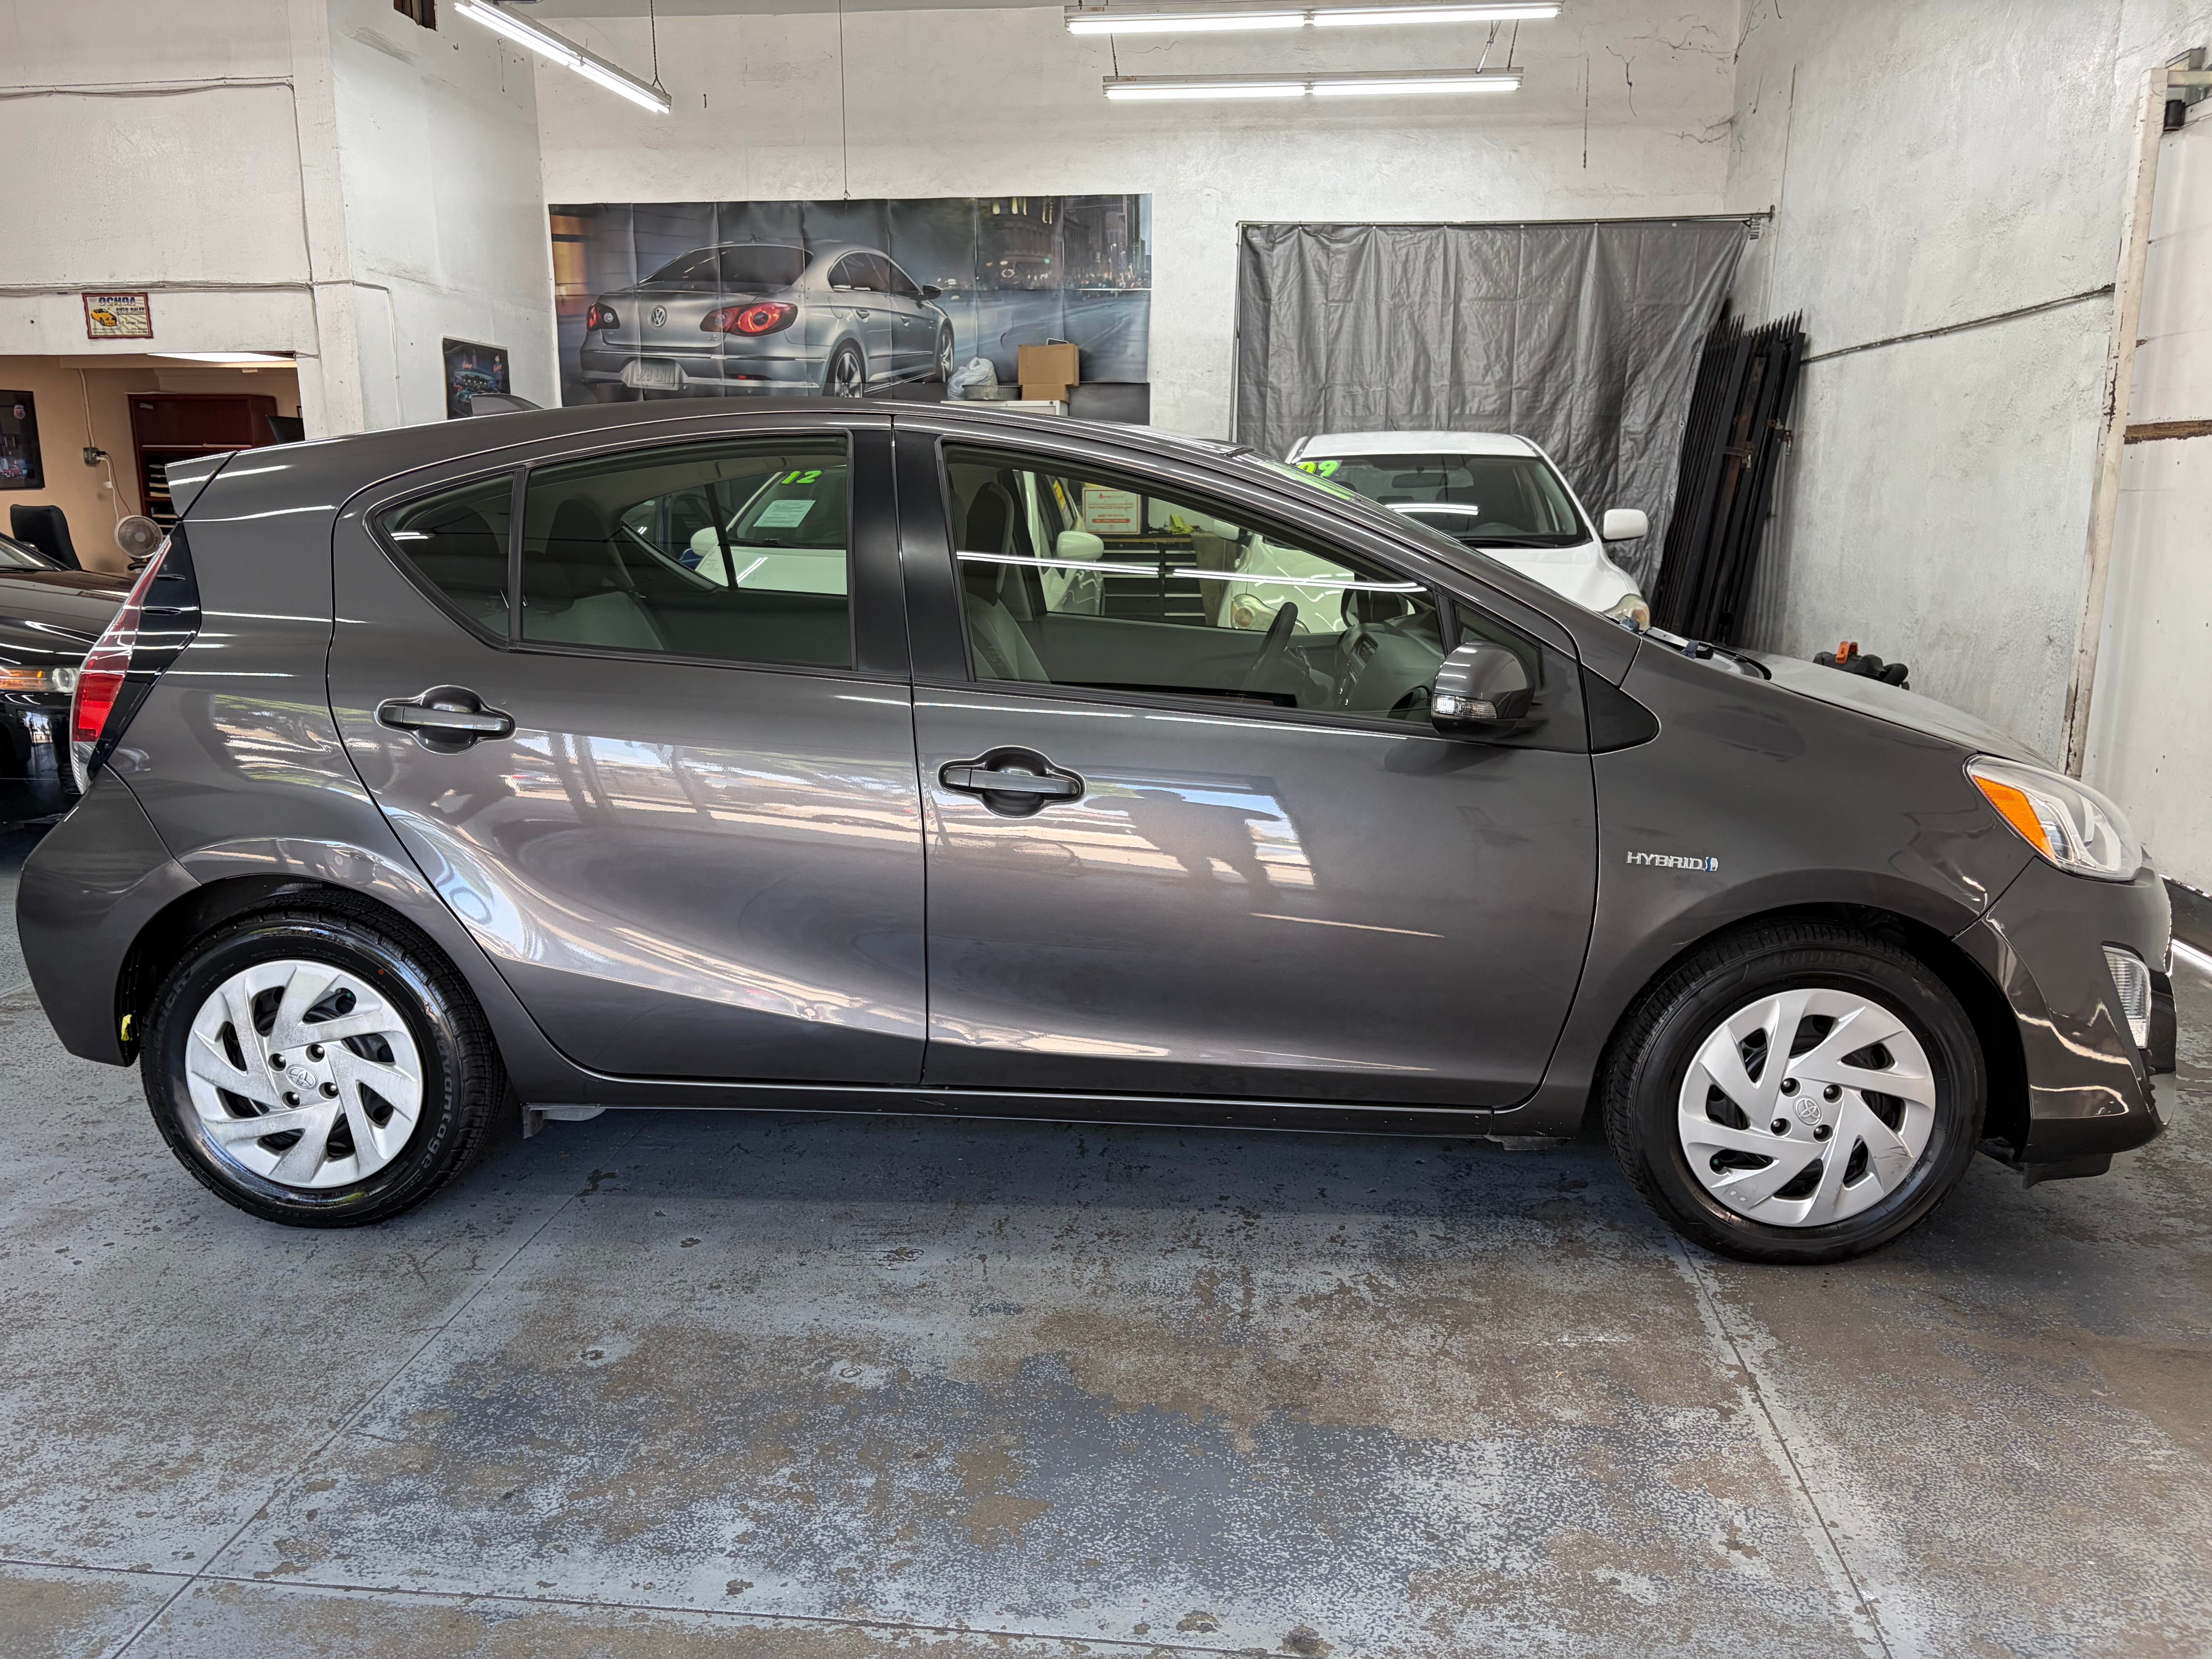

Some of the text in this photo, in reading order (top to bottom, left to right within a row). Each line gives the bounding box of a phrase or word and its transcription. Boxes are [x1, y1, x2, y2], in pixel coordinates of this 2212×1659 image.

[99, 297, 136, 306] OCHOA
[781, 470, 823, 484] 12
[1626, 851, 1703, 870] HYBRID
[421, 1019, 453, 1169] Advantage
